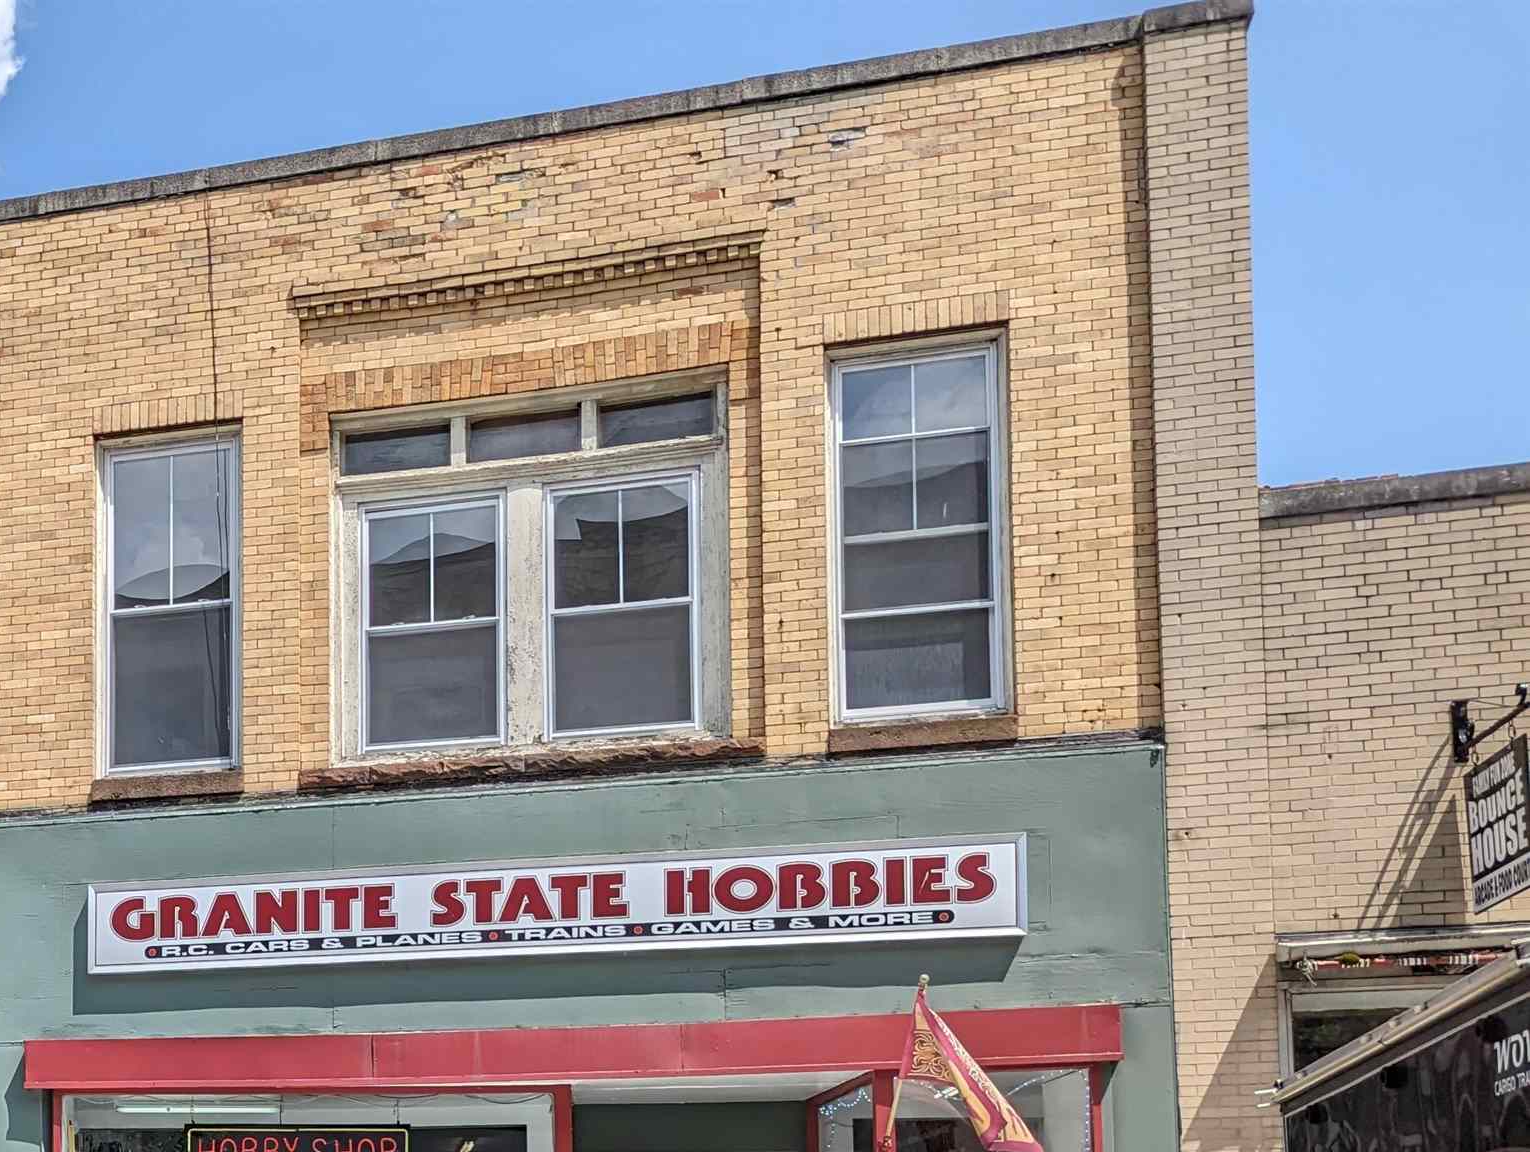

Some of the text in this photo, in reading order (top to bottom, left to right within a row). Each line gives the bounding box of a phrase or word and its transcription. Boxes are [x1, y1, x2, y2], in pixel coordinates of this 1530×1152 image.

[1470, 767, 1524, 834] BOUNCE
[1471, 806, 1528, 876] HOUSE
[110, 852, 997, 942] GRANITE STATE HOBBIES
[161, 911, 934, 957] R.C. CARS & PLANES TRAINS GAMES & MORE
